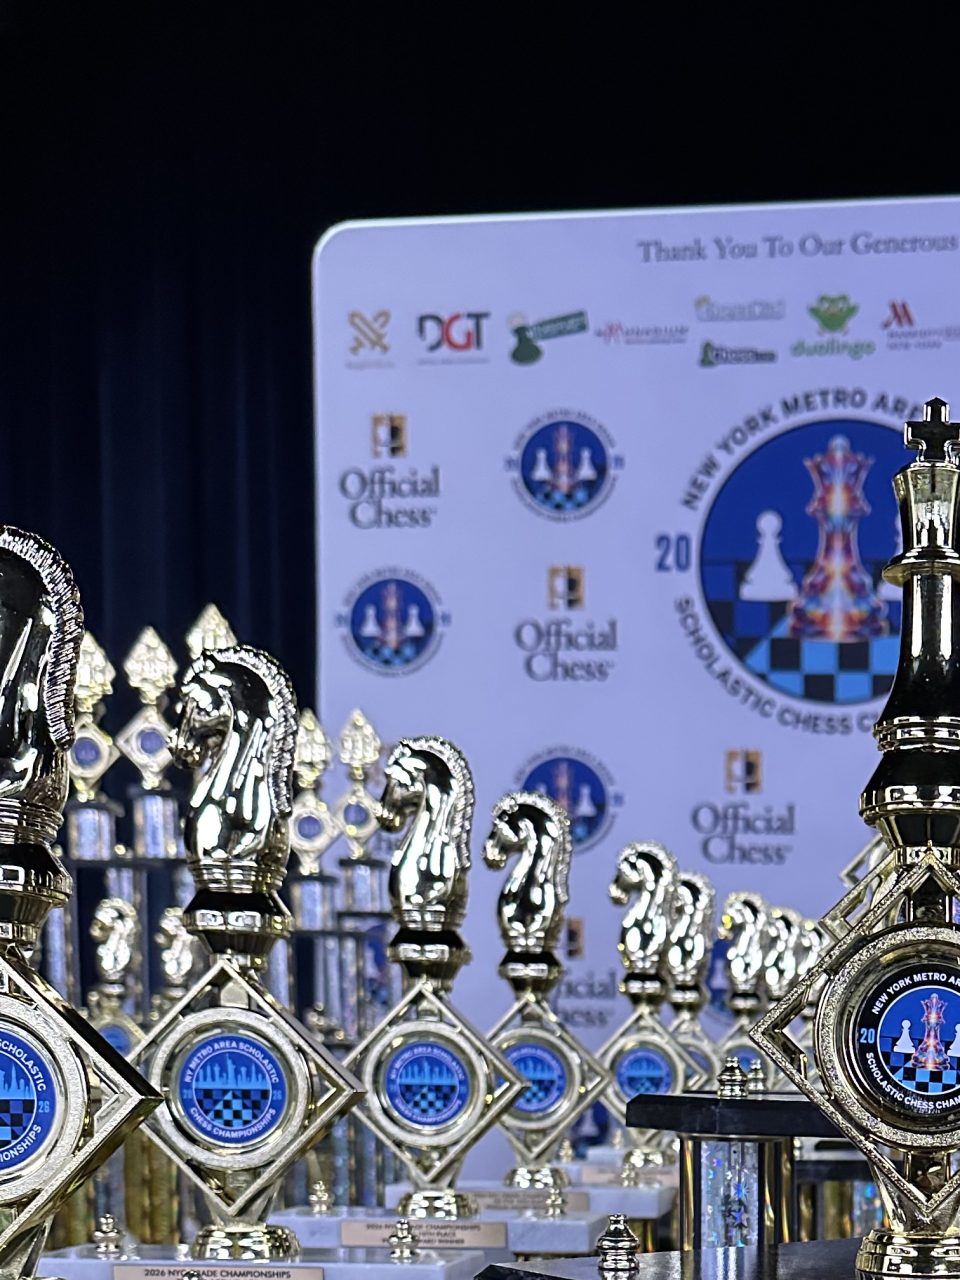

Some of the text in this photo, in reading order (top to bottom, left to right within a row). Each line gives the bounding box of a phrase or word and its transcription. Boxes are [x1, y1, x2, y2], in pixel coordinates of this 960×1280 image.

[637, 237, 707, 262] Thank
[713, 236, 758, 260] You
[762, 234, 794, 258] To
[799, 232, 845, 257] Our
[851, 231, 959, 255] Generous
[417, 311, 491, 352] DGT
[681, 388, 924, 510] NEW YORK METRO ARE
[339, 465, 440, 500] Official
[349, 499, 432, 530] Chess
[655, 534, 692, 572] 20
[513, 617, 617, 651] Official
[524, 651, 609, 682] Chess
[674, 595, 852, 736] SCHOLASTIC CHESS
[690, 801, 796, 835] Official
[701, 835, 787, 865] Chess
[871, 993, 890, 1015] NEW
[886, 977, 913, 994] YORK
[913, 972, 948, 983] METRO
[860, 1028, 875, 1044] 20
[0, 1039, 47, 1092] CHOLASTIC
[184, 1040, 280, 1084] NY METRO AREA SCHOLASTIC
[866, 1052, 905, 1102] SCHOLASTIC
[904, 1095, 935, 1110] CHESS
[38, 1100, 50, 1113] 26
[190, 1107, 277, 1139] CHESS CHAMPIONSHIPS
[144, 1269, 166, 1277] 2026
[219, 1269, 291, 1279] CHAMPIONSHIPS
